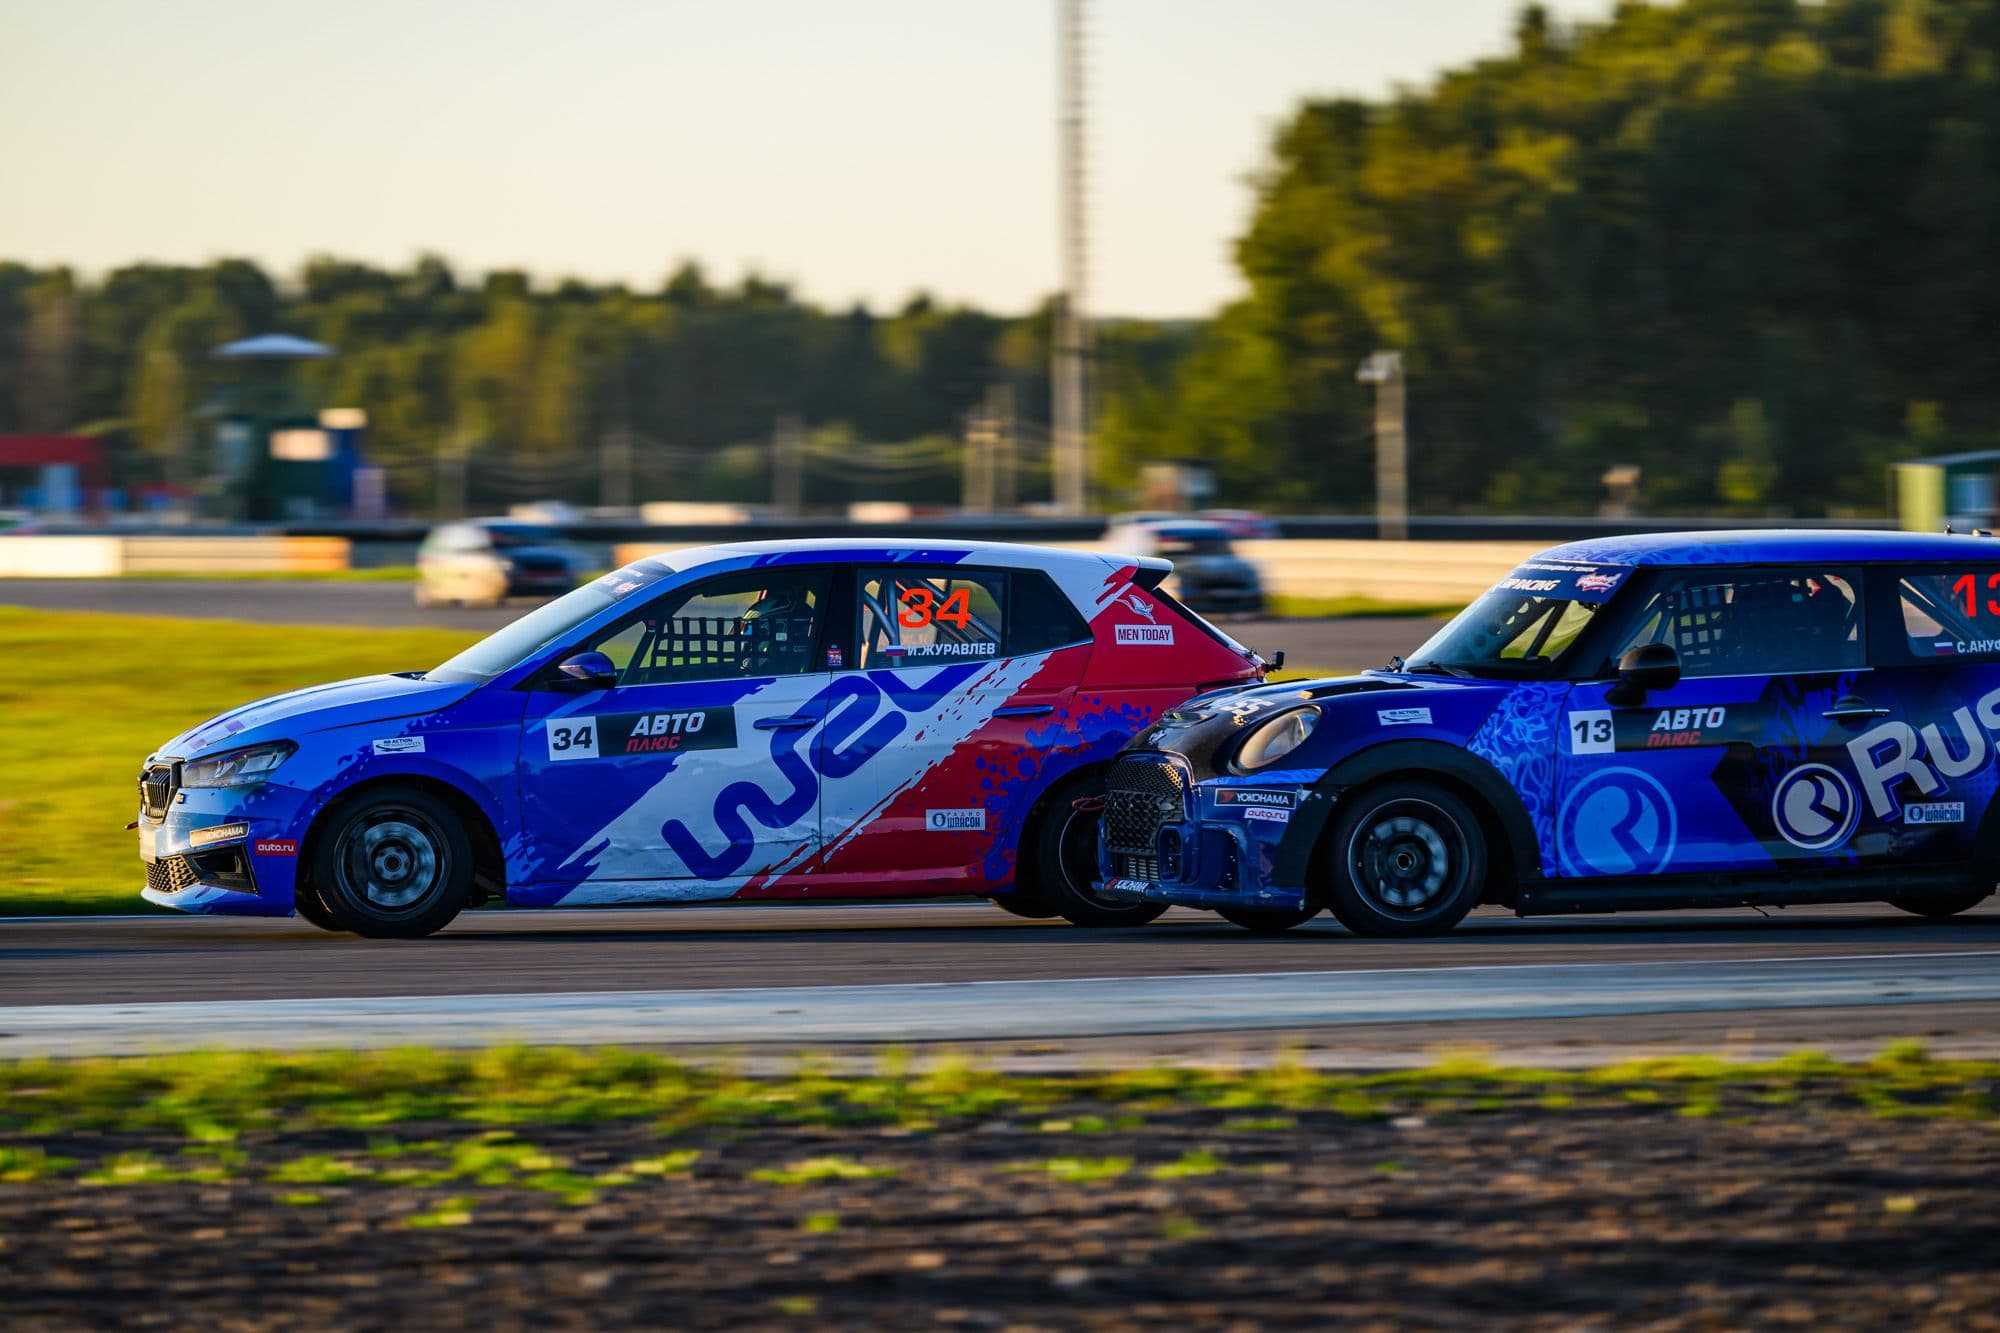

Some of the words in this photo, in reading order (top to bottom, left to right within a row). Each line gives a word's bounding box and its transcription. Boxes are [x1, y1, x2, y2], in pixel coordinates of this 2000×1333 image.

[898, 587, 972, 630] 34
[1117, 628, 1139, 641] MEN
[1140, 628, 1171, 641] TODAY
[907, 643, 996, 656] И.ЖУРАВЛЕВ
[630, 711, 706, 737] АВТО
[1651, 706, 1726, 731] АВТО
[552, 726, 593, 751] 34
[1573, 719, 1613, 744] 13
[1647, 731, 1702, 747] ПЛЮС
[625, 735, 682, 753] ПЛЮС
[1235, 792, 1290, 805] YOKOHAMA
[947, 816, 981, 828] ШАНСОН
[1247, 810, 1287, 819] auto.ru
[257, 842, 294, 852] auto.ru
